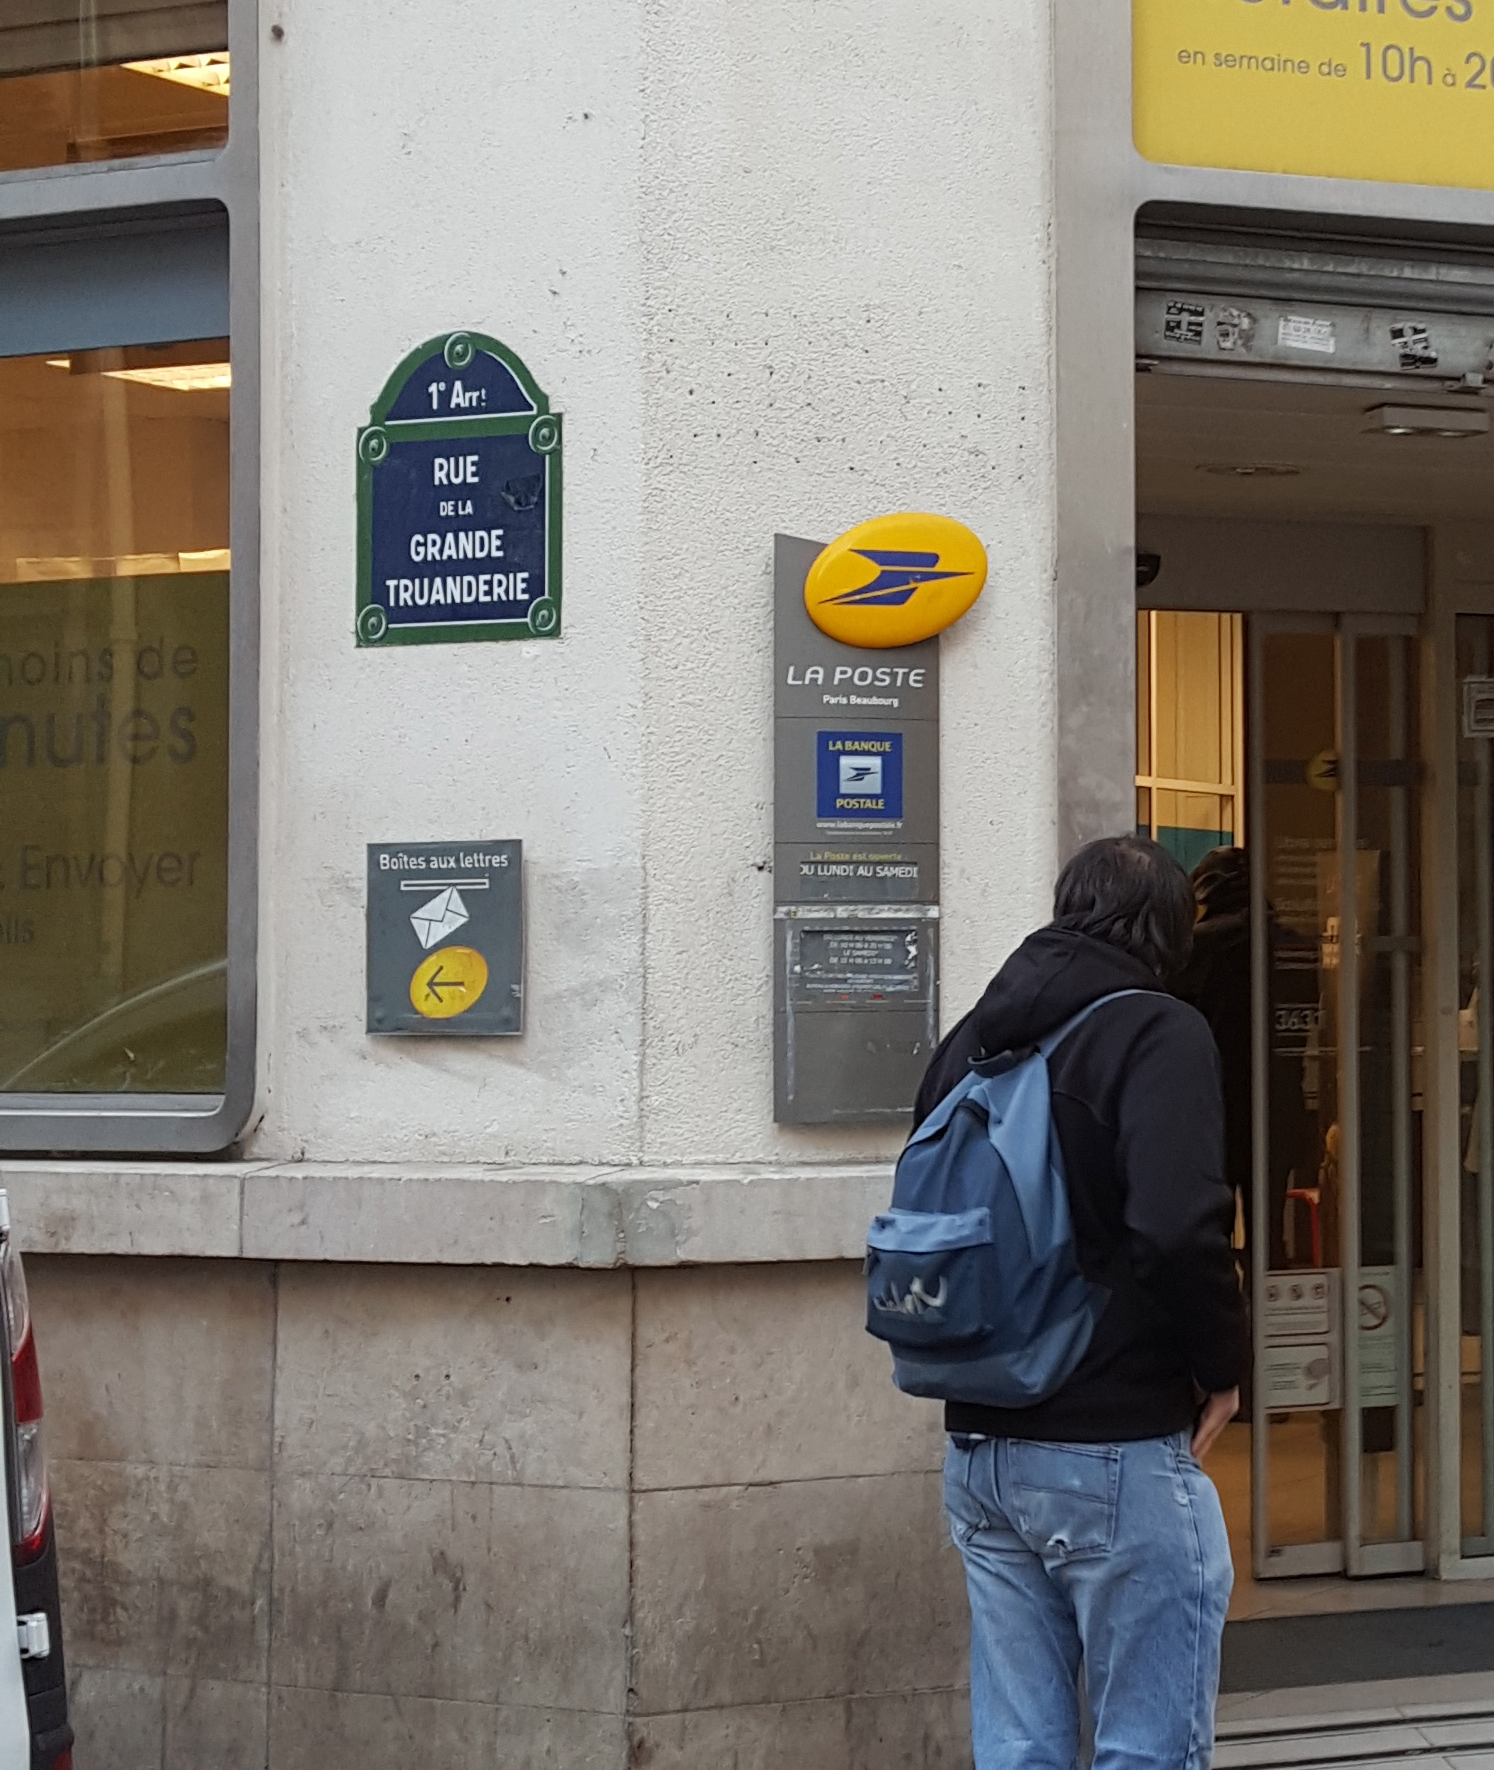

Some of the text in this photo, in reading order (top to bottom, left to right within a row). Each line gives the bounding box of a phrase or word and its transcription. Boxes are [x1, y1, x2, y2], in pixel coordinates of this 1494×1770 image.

[1177, 48, 1205, 66] en
[1213, 51, 1310, 75] semaine
[1318, 58, 1347, 78] de
[1359, 42, 1433, 86] 10h
[1442, 68, 1457, 88] à
[434, 455, 480, 486] RUE
[439, 499, 473, 516] DE LA
[410, 529, 504, 562] GRANDE
[385, 572, 530, 607] TRUANDERIE
[137, 635, 200, 681] de
[786, 665, 926, 689] LA POSTE
[823, 694, 899, 708] Paris Beaubourg
[828, 740, 892, 753] LA BANQUE
[836, 798, 885, 809] POSTALE
[379, 852, 508, 871] Boîtes aux lettres
[823, 850, 850, 861] Poste
[20, 843, 201, 900] Envoyer
[817, 864, 854, 877] LUNDI
[856, 865, 873, 877] AU
[875, 865, 918, 878] SAMEDI
